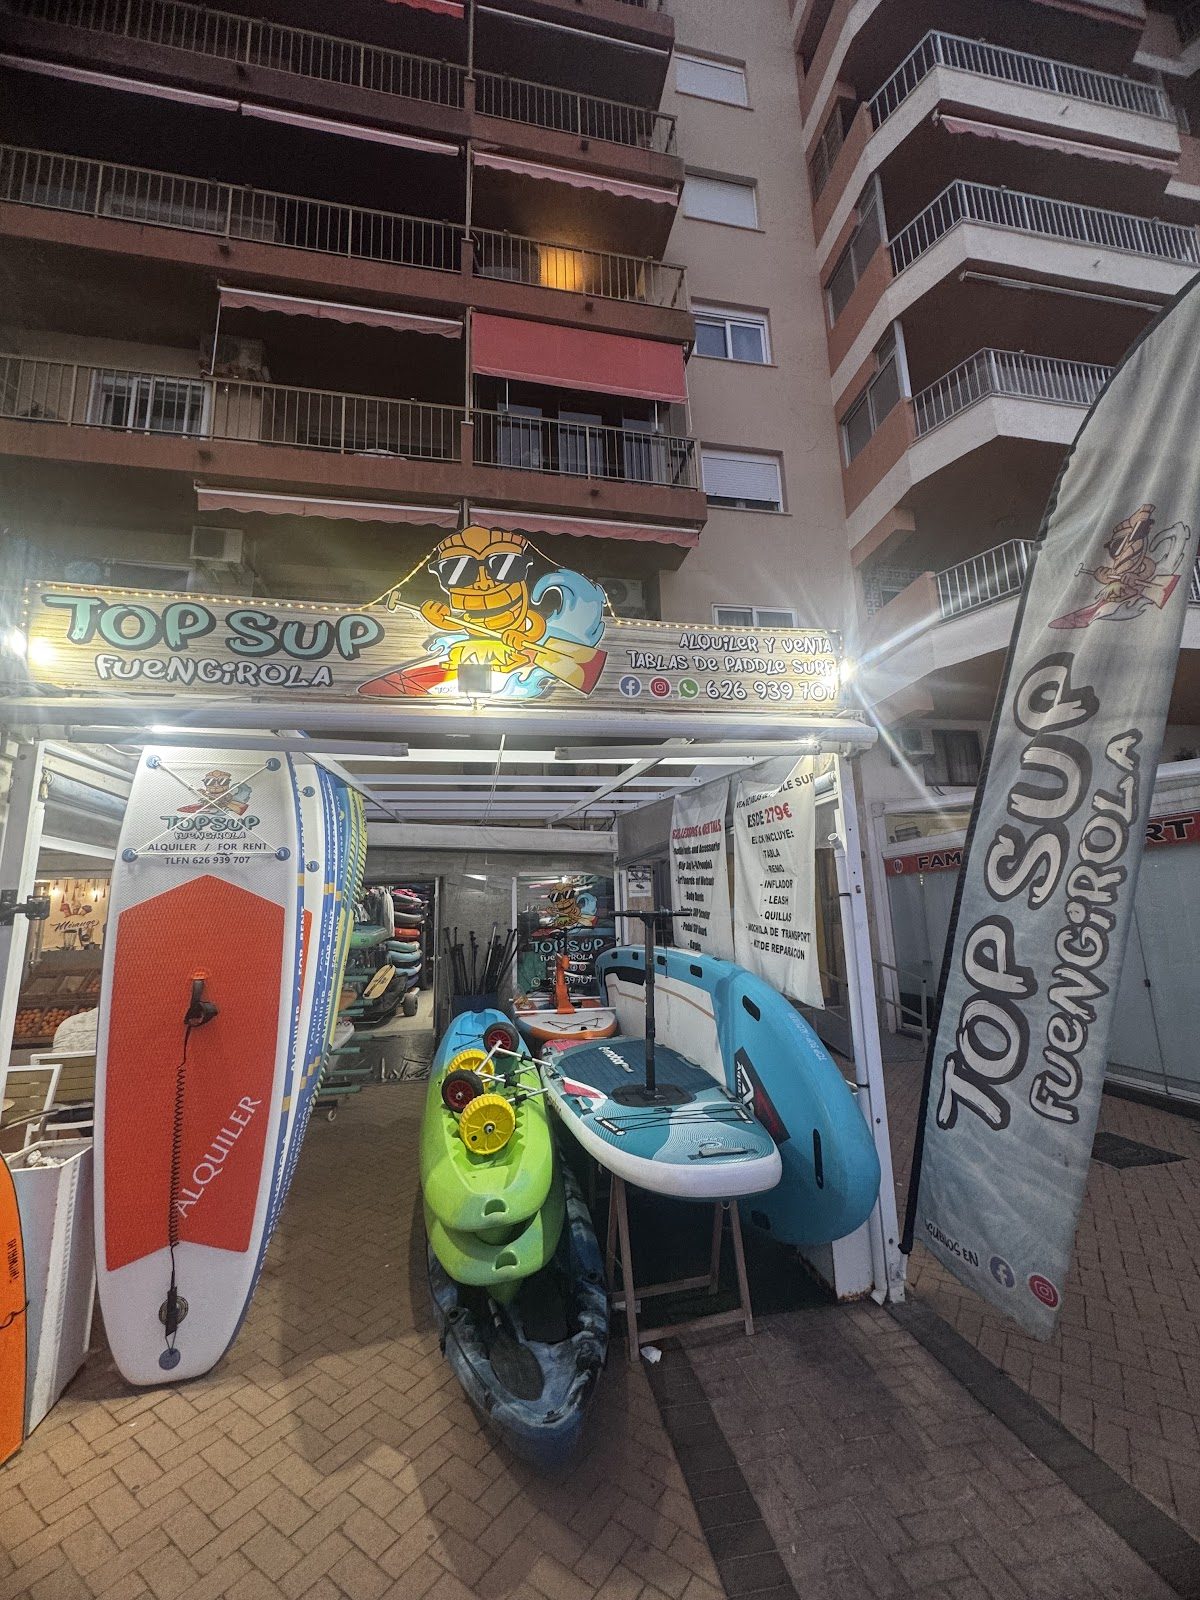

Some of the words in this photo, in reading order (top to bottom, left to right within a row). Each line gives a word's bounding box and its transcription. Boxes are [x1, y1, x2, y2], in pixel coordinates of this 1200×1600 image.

[42, 594, 216, 651] TOP
[225, 609, 384, 660] SUP
[764, 635, 775, 653] Y
[627, 650, 689, 671] TABLAS
[706, 679, 747, 700] 626
[753, 681, 793, 700] 939
[983, 651, 1099, 911] SUP
[148, 843, 197, 852] ALQUILER
[218, 843, 237, 851] FOR
[243, 842, 267, 851] RENT
[165, 857, 190, 865] TLFN
[768, 895, 789, 905] LEASH
[770, 927, 779, 937] DE
[567, 938, 604, 952] SUP
[760, 941, 770, 951] DE
[937, 914, 1039, 1131] TOP
[176, 1096, 262, 1219] ALQUILER
